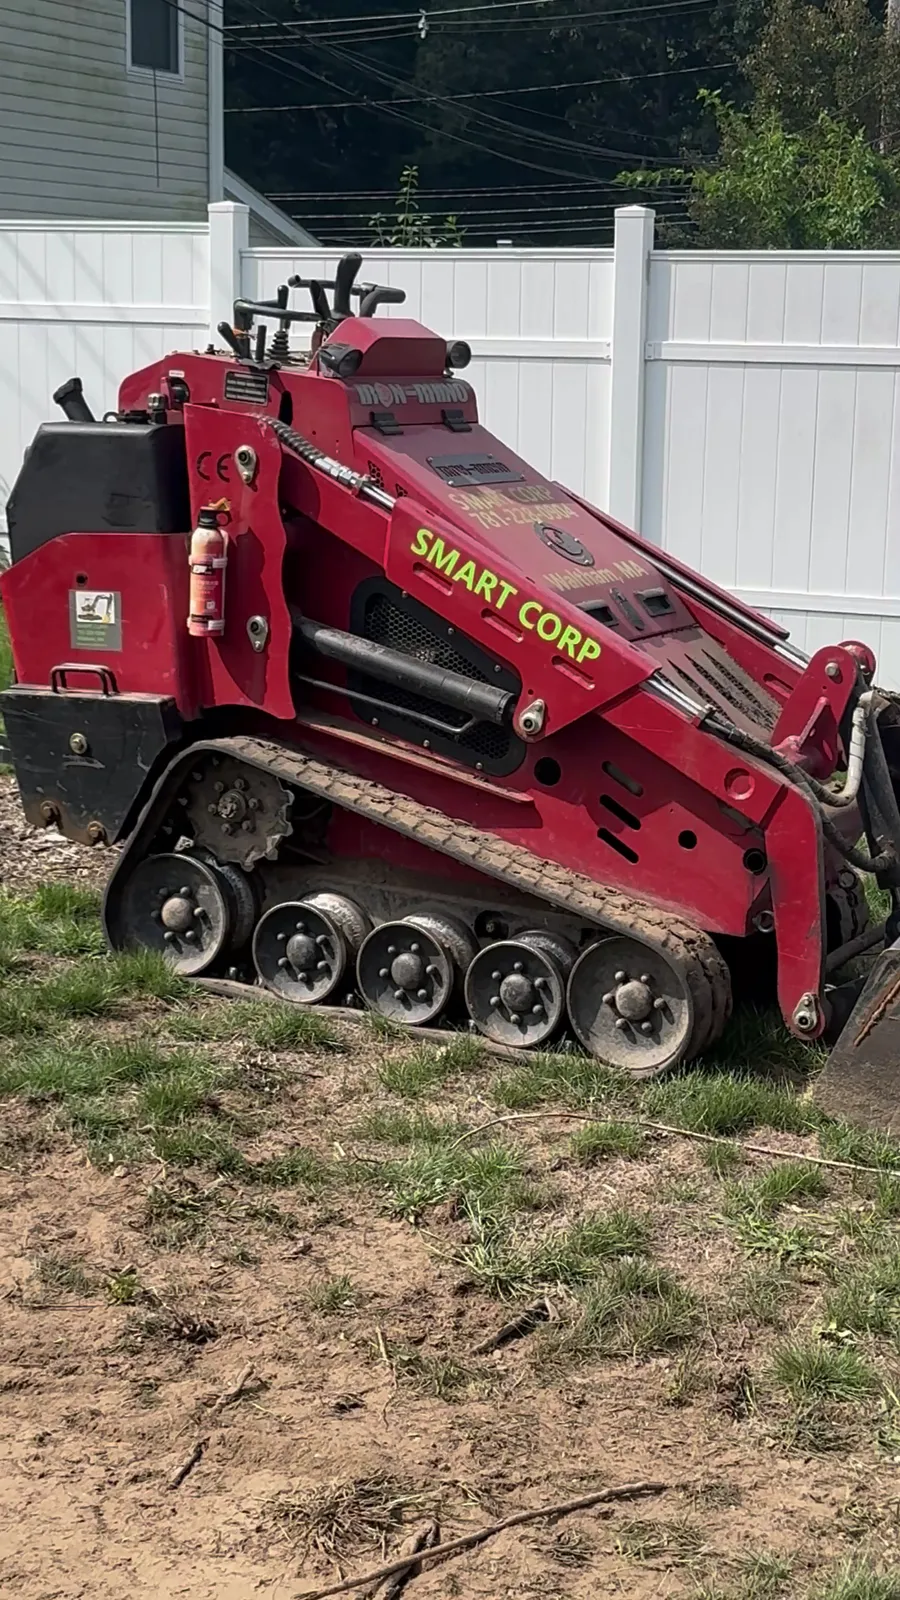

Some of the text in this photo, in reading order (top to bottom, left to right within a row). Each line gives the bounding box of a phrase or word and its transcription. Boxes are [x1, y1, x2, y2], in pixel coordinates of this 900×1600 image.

[448, 484, 554, 511] SMART CORP
[613, 560, 649, 579] MA
[410, 528, 601, 663] SMART CORP
